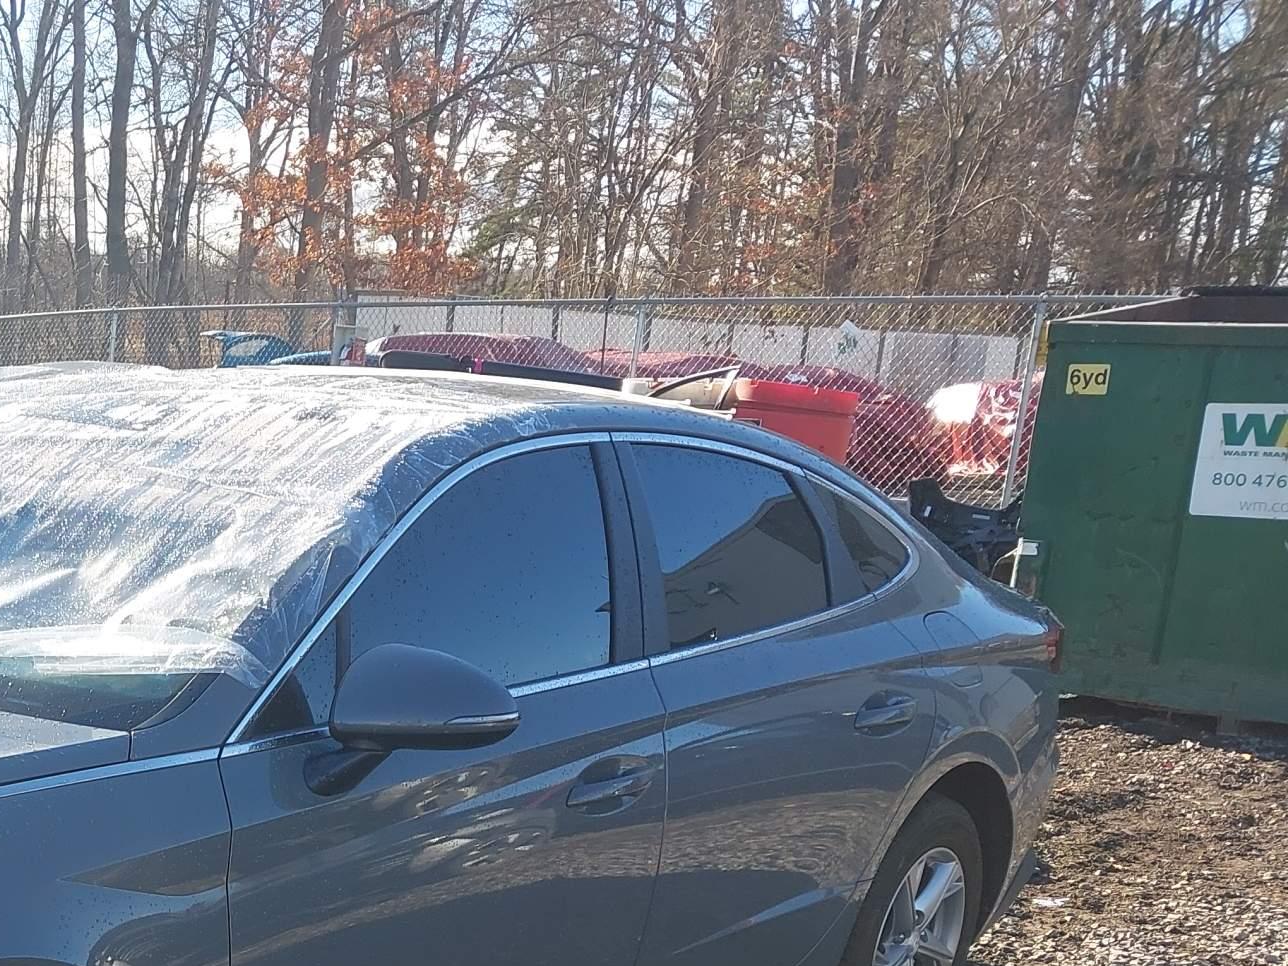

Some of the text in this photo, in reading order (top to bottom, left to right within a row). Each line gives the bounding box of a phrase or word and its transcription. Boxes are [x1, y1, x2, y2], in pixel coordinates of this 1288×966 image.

[1070, 368, 1108, 390] 6yd
[1222, 413, 1288, 447] W
[1212, 472, 1288, 489] 800 476
